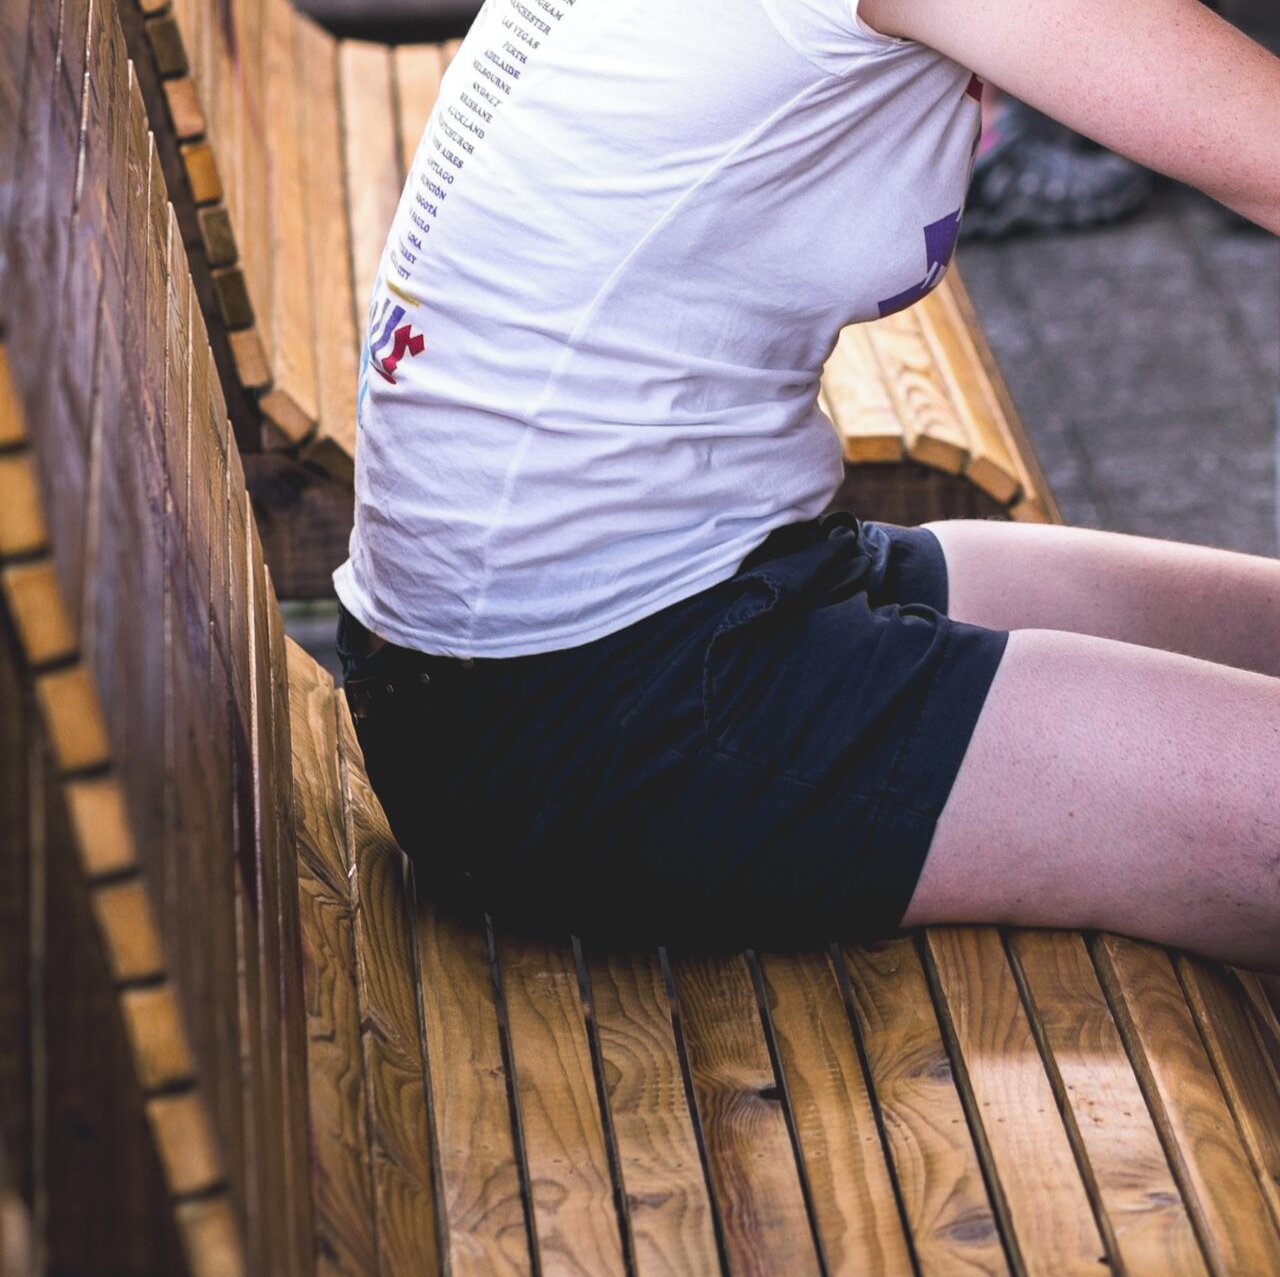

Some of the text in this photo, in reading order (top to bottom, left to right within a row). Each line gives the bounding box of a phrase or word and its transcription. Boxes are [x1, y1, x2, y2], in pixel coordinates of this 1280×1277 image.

[502, 41, 528, 64] PERTH
[514, 25, 541, 50] VEGAS
[473, 59, 512, 95] MELBOURNE
[484, 49, 521, 80] ADELAIDE
[448, 105, 485, 139] AUCKLAND
[460, 92, 493, 124] BRISBANE
[442, 146, 464, 169] AIRES
